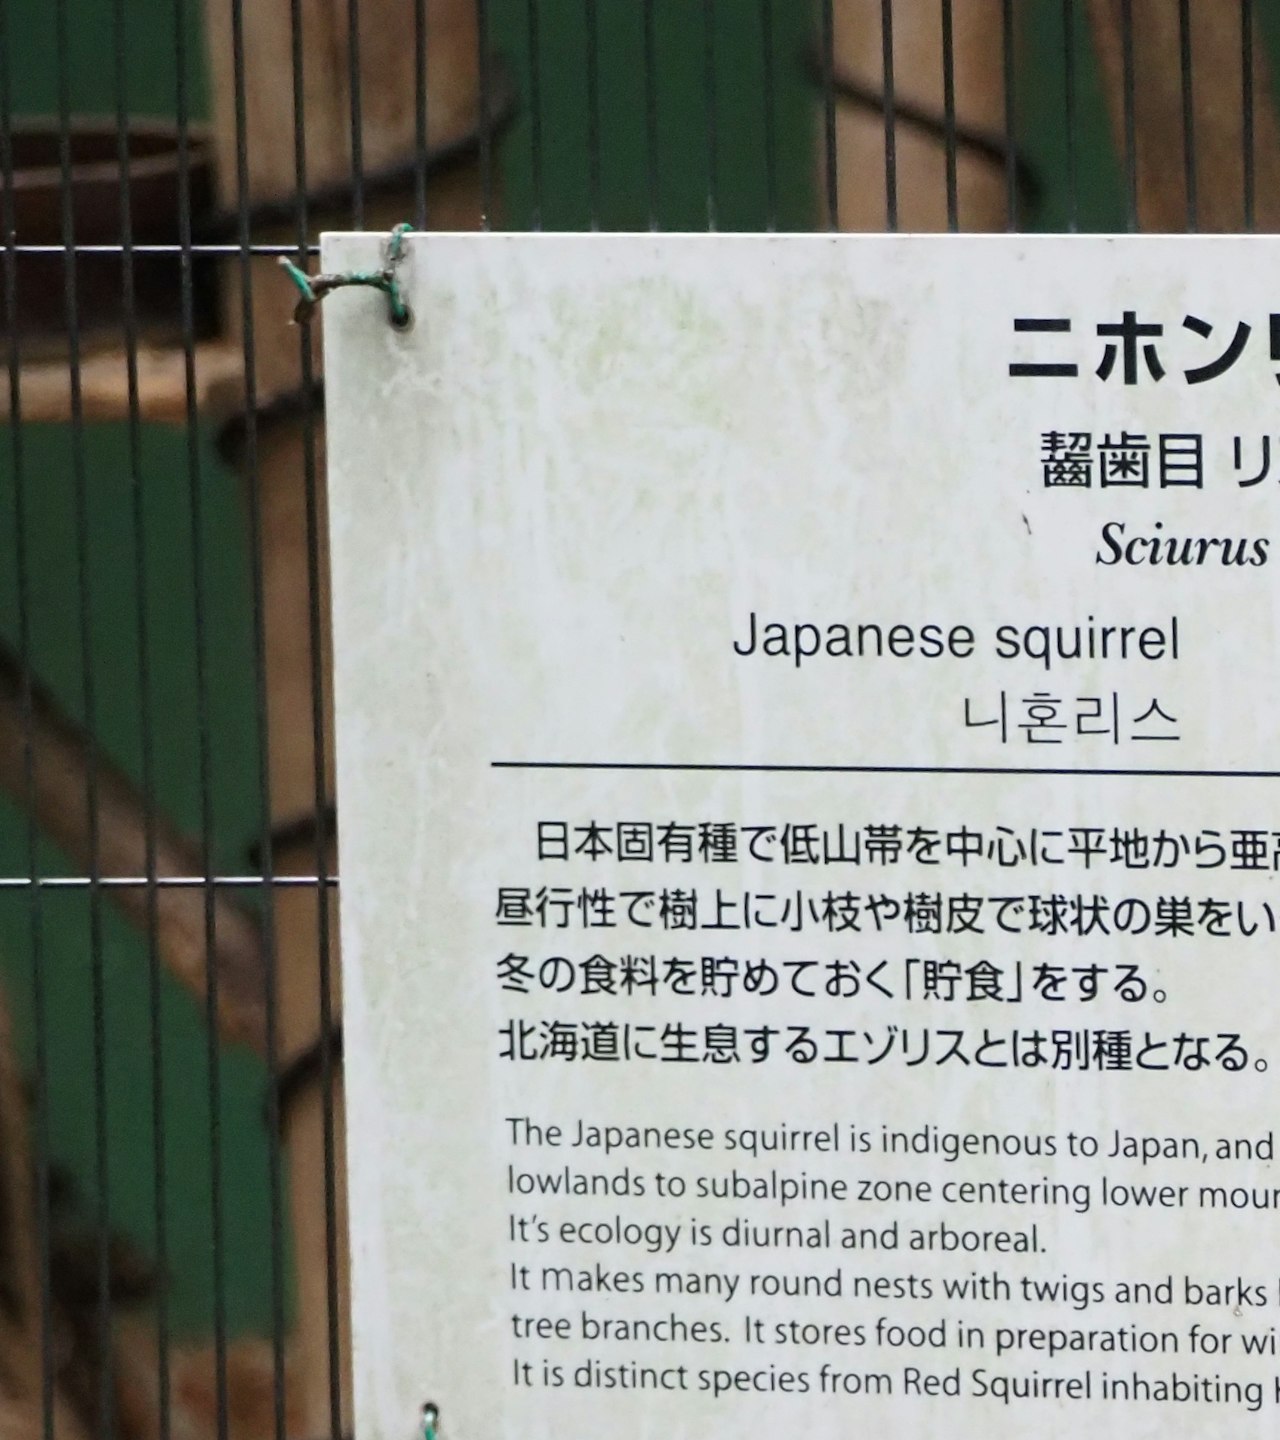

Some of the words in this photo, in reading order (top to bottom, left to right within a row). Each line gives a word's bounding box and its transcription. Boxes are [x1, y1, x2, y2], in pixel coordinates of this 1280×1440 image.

[1039, 429, 1204, 490] 齧歯目
[1095, 520, 1271, 567] Sciurus
[732, 611, 976, 669] Japanese
[995, 614, 1179, 672] squirrel
[964, 689, 1181, 746] 니혼리스
[496, 951, 1167, 1004] 冬の食料を貯めておく「貯食」をする。
[497, 1018, 1268, 1073] 北海道に生息するエゾリスとは別種となる。
[504, 1116, 563, 1147] The
[571, 1119, 715, 1156] Japanese
[724, 1121, 839, 1158] squirrel
[850, 1123, 872, 1153] is
[881, 1123, 1058, 1163] indigenous
[1066, 1131, 1099, 1158] to
[1107, 1129, 1208, 1167] Japan,
[1215, 1130, 1274, 1161] and
[508, 1164, 646, 1197] lowlands
[654, 1172, 687, 1198] to
[696, 1168, 848, 1208] subalpine
[856, 1179, 933, 1203] zone
[941, 1175, 1091, 1214] centering
[1102, 1175, 1190, 1208] lower
[509, 1213, 550, 1244] It's
[559, 1214, 682, 1254] ecology
[690, 1217, 713, 1247] is
[721, 1217, 831, 1249] diurnal
[840, 1220, 899, 1251] and
[909, 1220, 1047, 1254] arboreal.
[511, 1262, 531, 1291] It
[541, 1262, 645, 1294] makes
[655, 1272, 741, 1303] many
[750, 1267, 843, 1298] round
[853, 1273, 934, 1300] nests
[942, 1270, 1011, 1301] with
[1019, 1273, 1106, 1311] twigs
[1114, 1274, 1173, 1305] and
[1184, 1274, 1268, 1307] barks
[510, 1313, 572, 1340] tree
[581, 1309, 730, 1344] branches.
[745, 1315, 766, 1345] It
[774, 1319, 867, 1347] stores
[874, 1316, 947, 1348] food
[957, 1319, 985, 1349] in
[995, 1323, 1179, 1359] preparation
[1187, 1325, 1232, 1356] for
[513, 1358, 533, 1388] It
[543, 1358, 565, 1388] is
[573, 1358, 689, 1391] distinct
[697, 1363, 810, 1399] species
[818, 1363, 893, 1395] from
[903, 1366, 961, 1397] Red
[971, 1368, 1092, 1406] Squirrel
[1102, 1370, 1263, 1413] inhabiting
